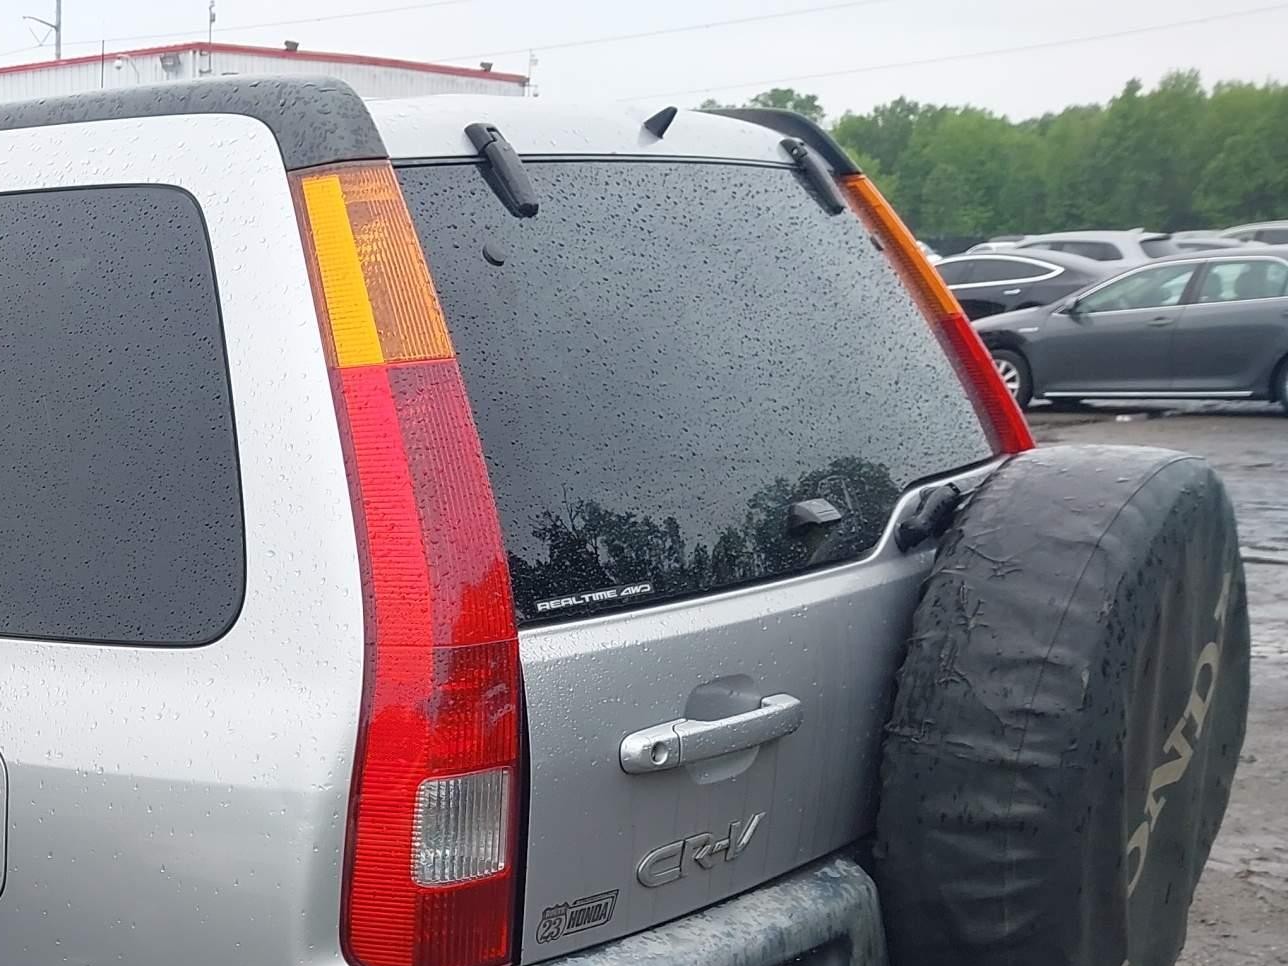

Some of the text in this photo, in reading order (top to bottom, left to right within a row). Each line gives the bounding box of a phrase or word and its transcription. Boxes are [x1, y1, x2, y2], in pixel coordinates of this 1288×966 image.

[620, 584, 651, 596] 4WD
[637, 812, 766, 888] CR-V
[540, 917, 563, 941] 23
[566, 902, 609, 930] HONDA
